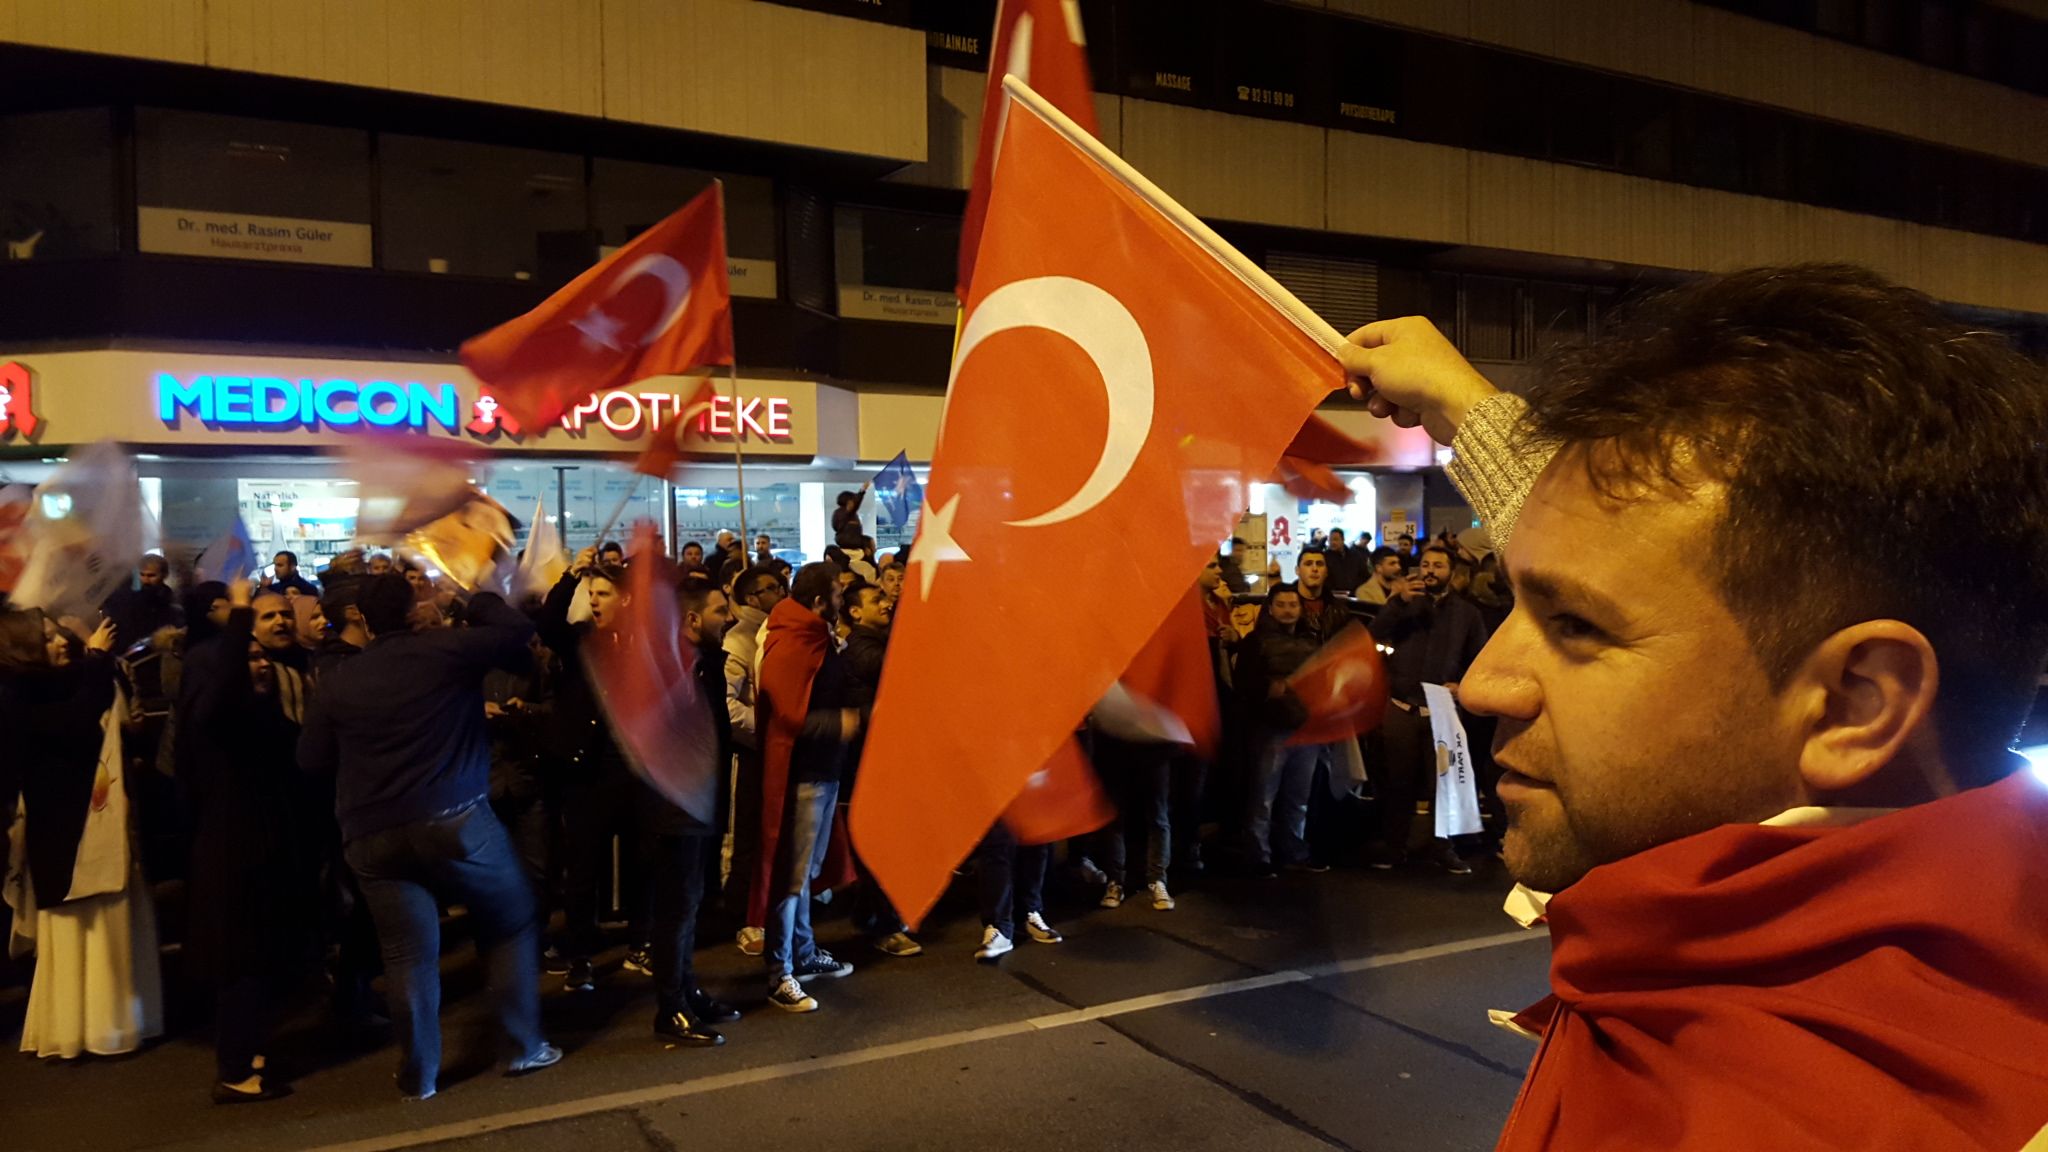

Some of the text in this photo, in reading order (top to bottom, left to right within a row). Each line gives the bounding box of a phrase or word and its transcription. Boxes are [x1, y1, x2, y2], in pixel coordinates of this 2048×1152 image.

[1155, 72, 1191, 91] MASSAGE
[177, 217, 333, 242] Dr. med. Rasim Güler
[158, 373, 456, 428] MEDICON
[561, 390, 790, 436] POTEKE
